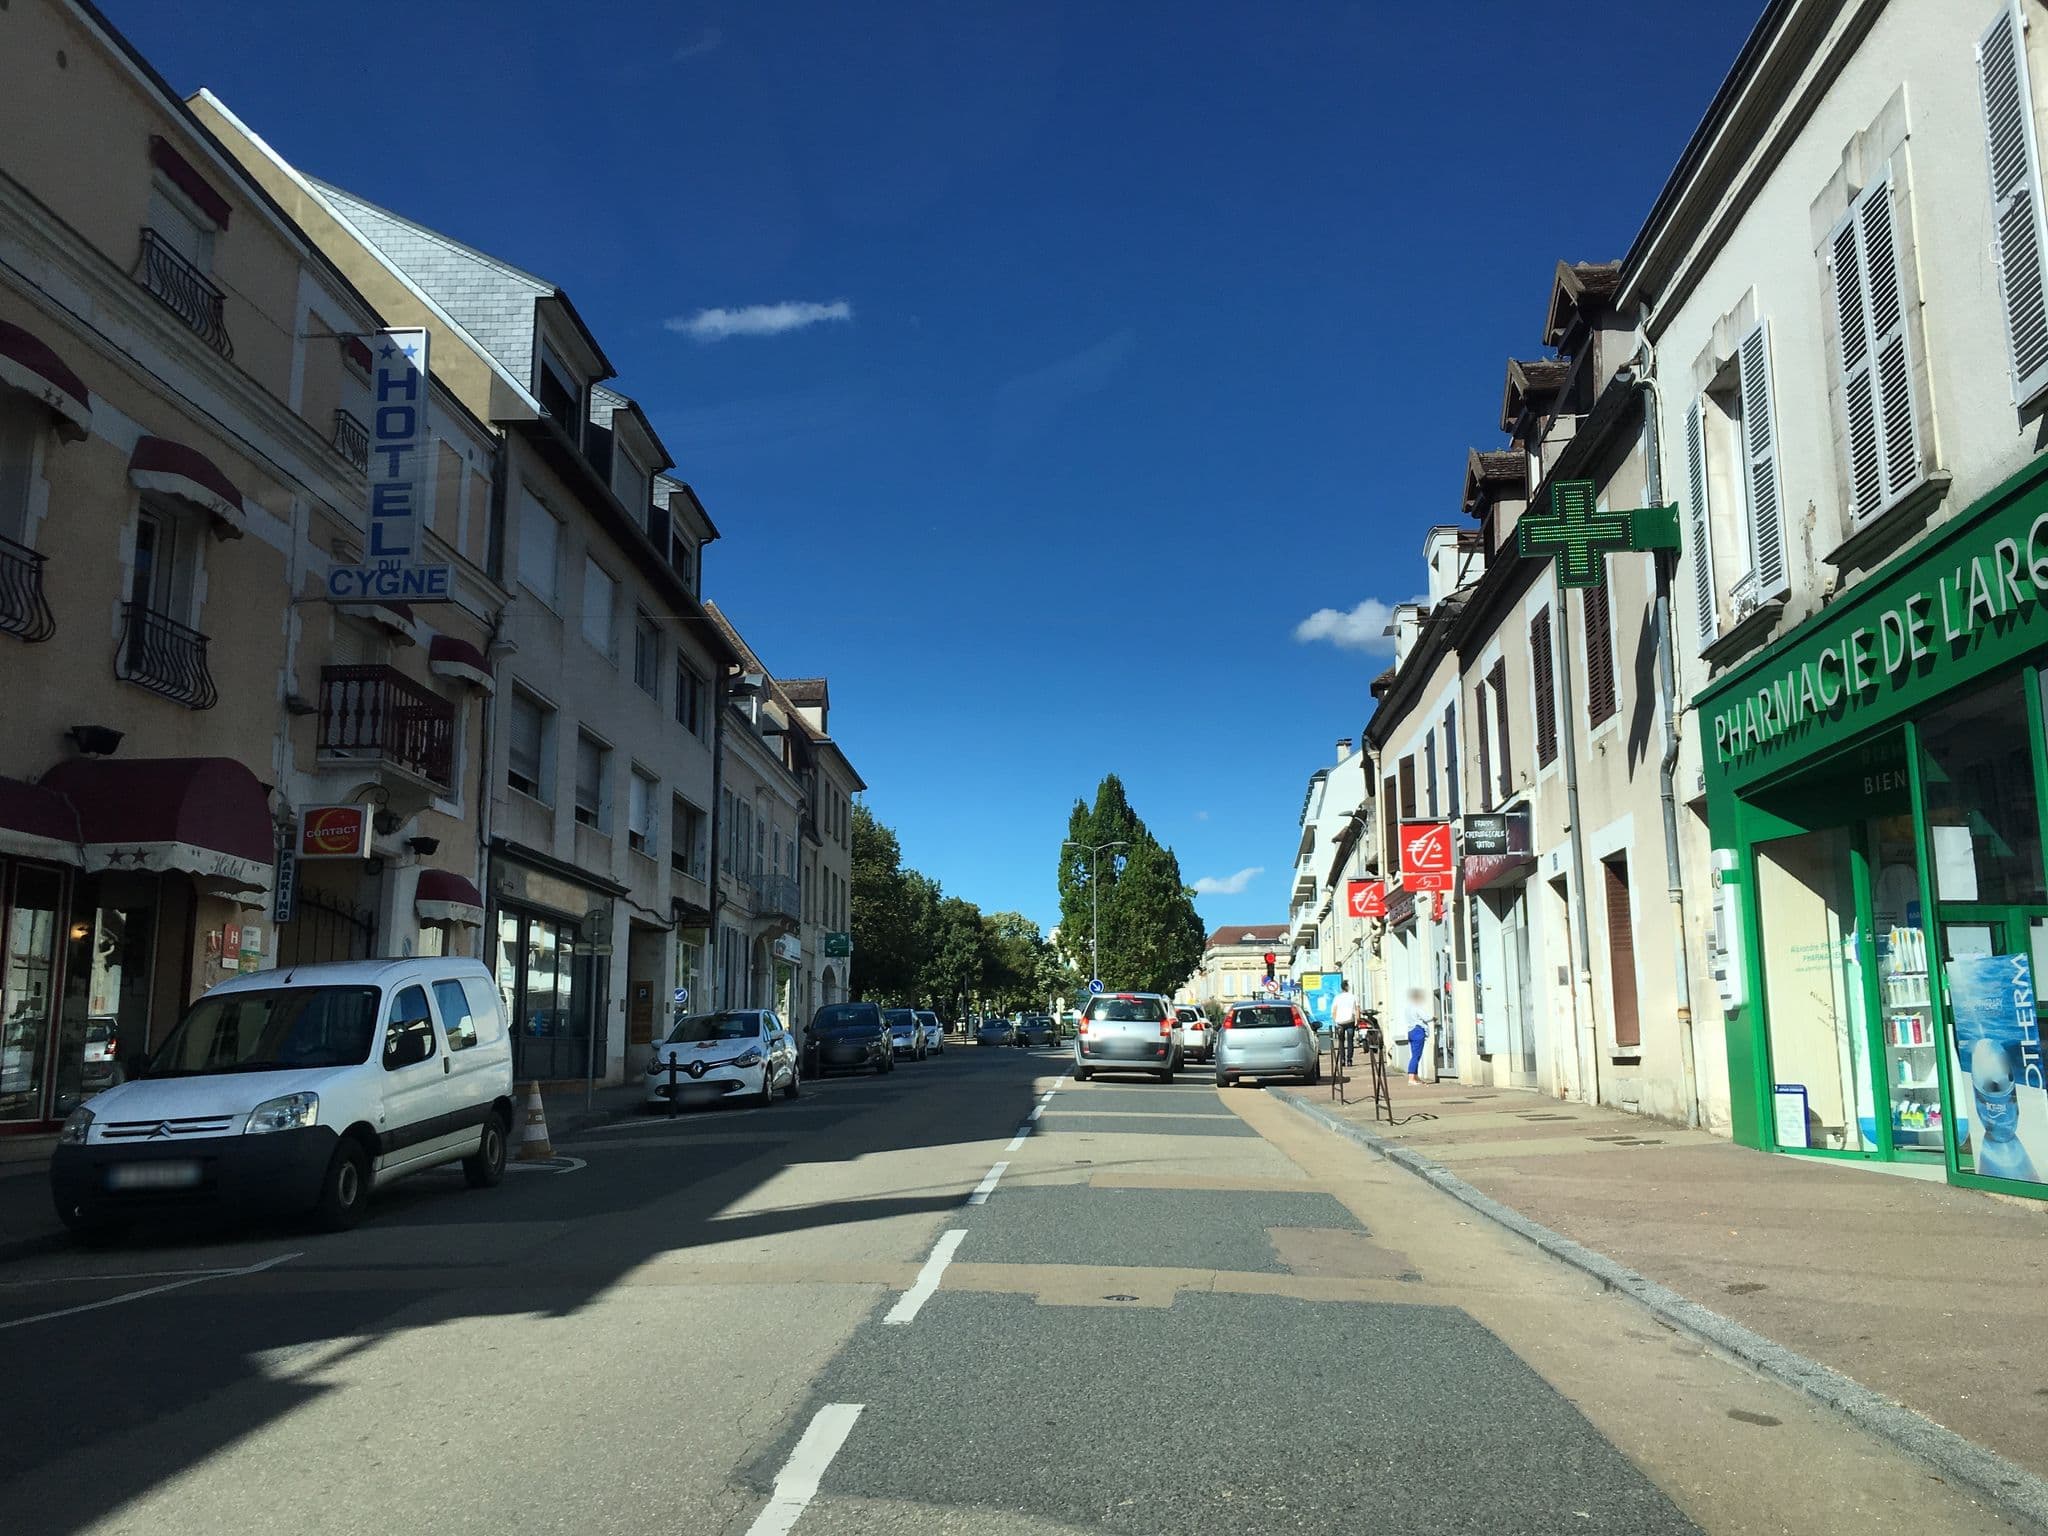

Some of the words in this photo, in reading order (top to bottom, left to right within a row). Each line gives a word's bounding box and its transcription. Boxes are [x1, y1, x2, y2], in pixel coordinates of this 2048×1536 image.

[369, 366, 417, 557] HOTEL
[377, 558, 402, 574] DU
[328, 568, 449, 597] CYGNE
[1713, 627, 1870, 764] PHARMACIE
[1879, 591, 1929, 675] DE
[1863, 769, 1907, 795] BIEN
[278, 851, 293, 920] PARKING
[230, 930, 239, 945] H
